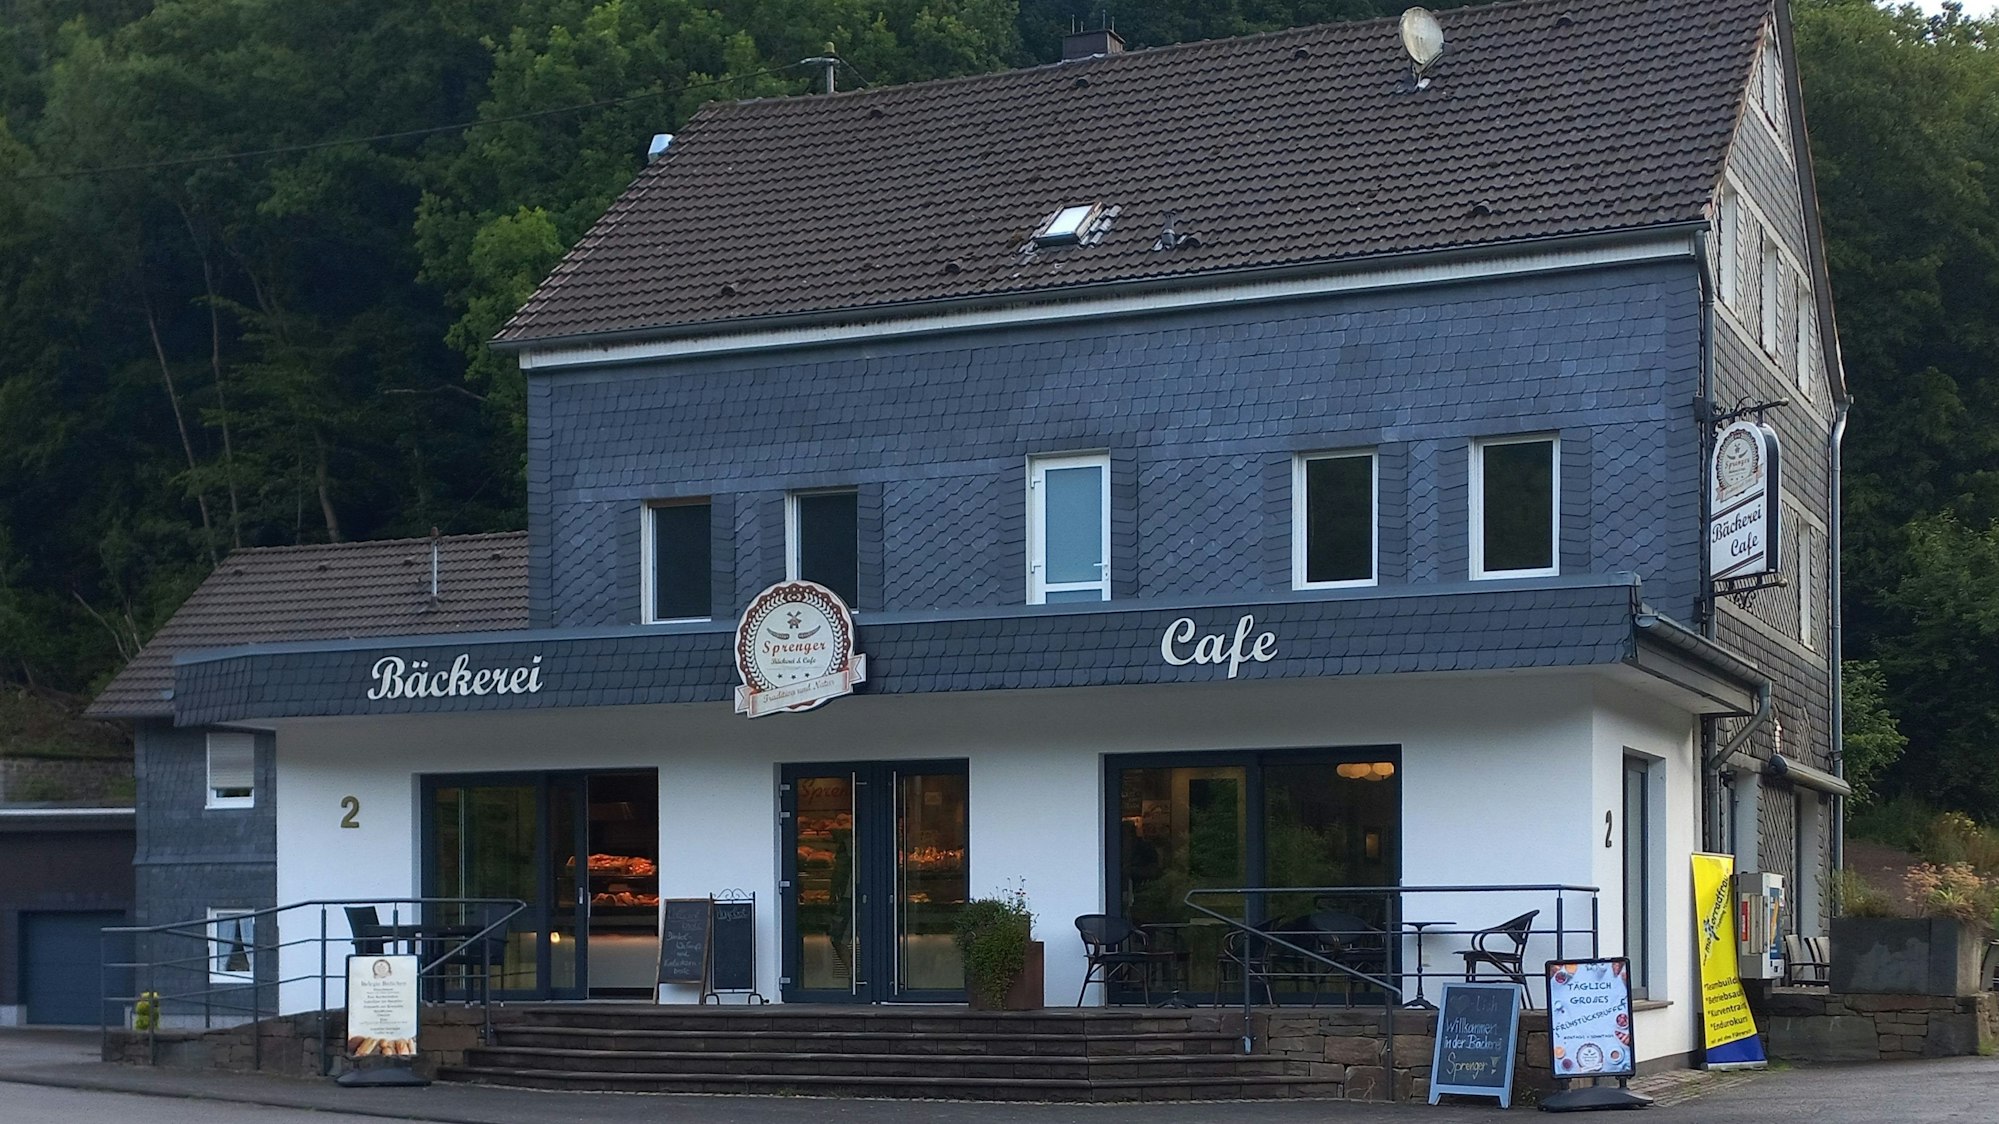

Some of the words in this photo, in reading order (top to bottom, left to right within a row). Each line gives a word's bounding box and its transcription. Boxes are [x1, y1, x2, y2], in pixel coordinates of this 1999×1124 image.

[1712, 504, 1762, 543] Bäckerei
[1731, 532, 1759, 557] Cafe
[762, 640, 827, 657] Sprenger
[1160, 613, 1279, 679] Cafe
[367, 653, 543, 700] Bäckerei
[340, 795, 360, 828] 2
[1605, 809, 1613, 848] 2
[1567, 980, 1612, 991] TÄGLICH
